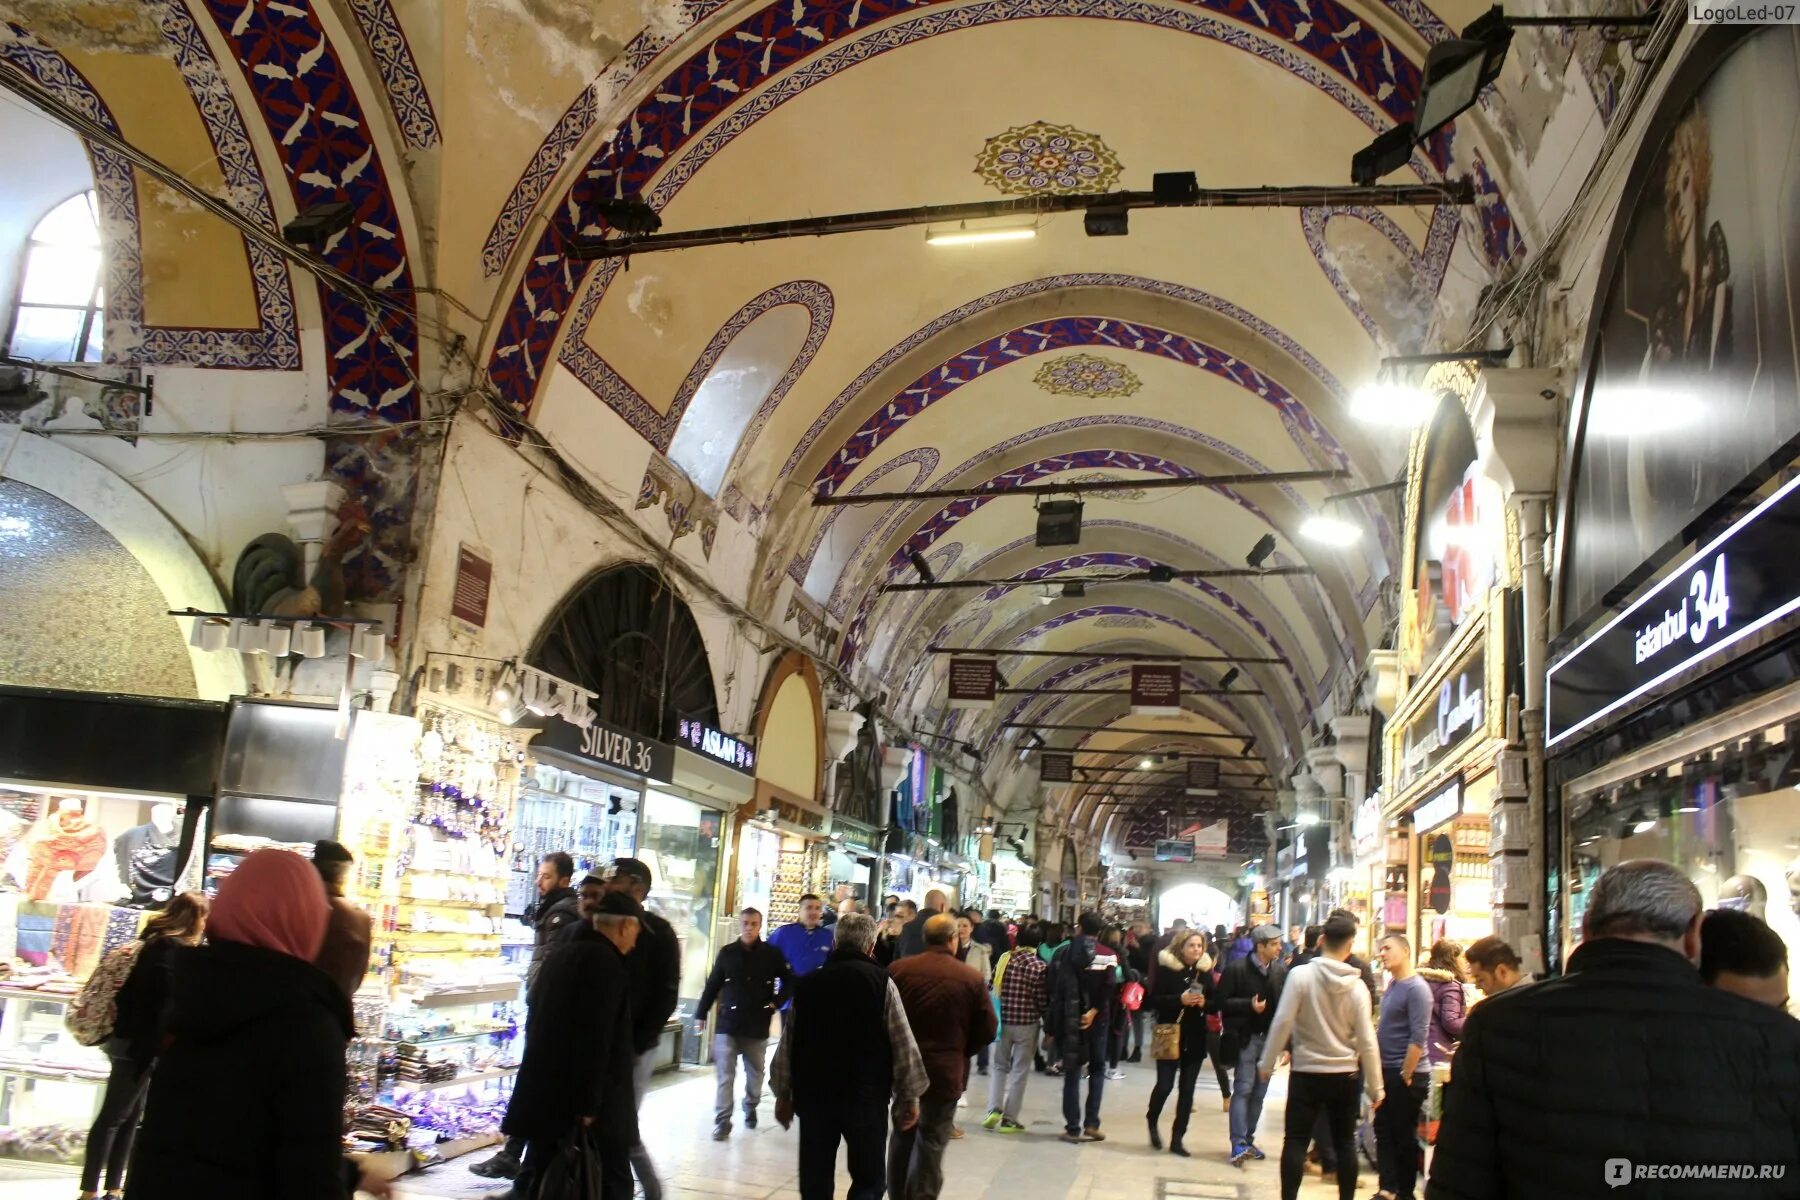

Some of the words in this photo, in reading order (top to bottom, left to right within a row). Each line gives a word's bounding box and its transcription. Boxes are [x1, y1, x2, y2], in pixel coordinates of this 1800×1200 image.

[1635, 596, 1687, 664] istanbul
[1689, 552, 1729, 644] 34
[580, 725, 632, 767] SILVER
[634, 741, 652, 773] 36
[702, 728, 736, 763] ASLAN
